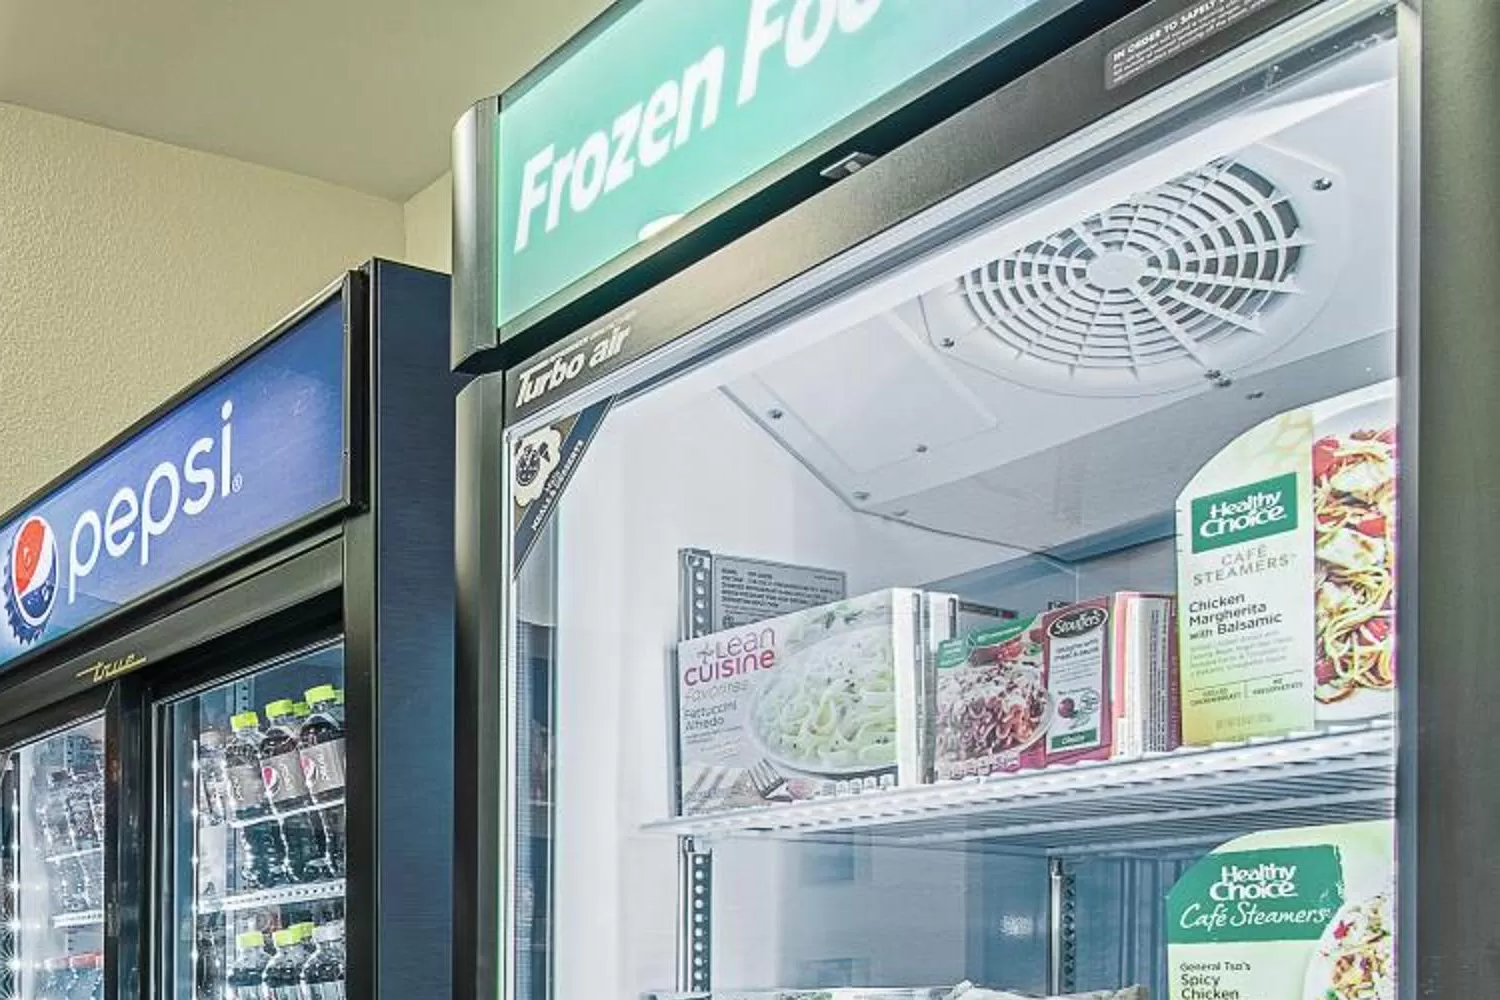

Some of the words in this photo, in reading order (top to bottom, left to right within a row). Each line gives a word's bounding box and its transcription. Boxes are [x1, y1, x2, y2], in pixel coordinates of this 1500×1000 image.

[514, 45, 726, 254] Frozen
[516, 343, 585, 407] Turbo
[67, 399, 234, 604] pepsi
[1210, 491, 1282, 518] Healthy
[1199, 504, 1287, 538] Choice
[1193, 553, 1291, 587] STEAMERS
[1188, 593, 1245, 613] Chicken
[1188, 602, 1268, 627] Margherita
[1189, 628, 1213, 640] with
[1216, 613, 1283, 636] Balsamic
[1221, 862, 1297, 885] Healthy
[1209, 880, 1299, 901] Choice
[1179, 903, 1227, 932] Café
[1229, 900, 1326, 927] Steamers
[1180, 962, 1221, 972] General
[1225, 961, 1251, 972] Tso's
[1180, 974, 1221, 988] Spicy
[1180, 988, 1240, 1000] Chicken
